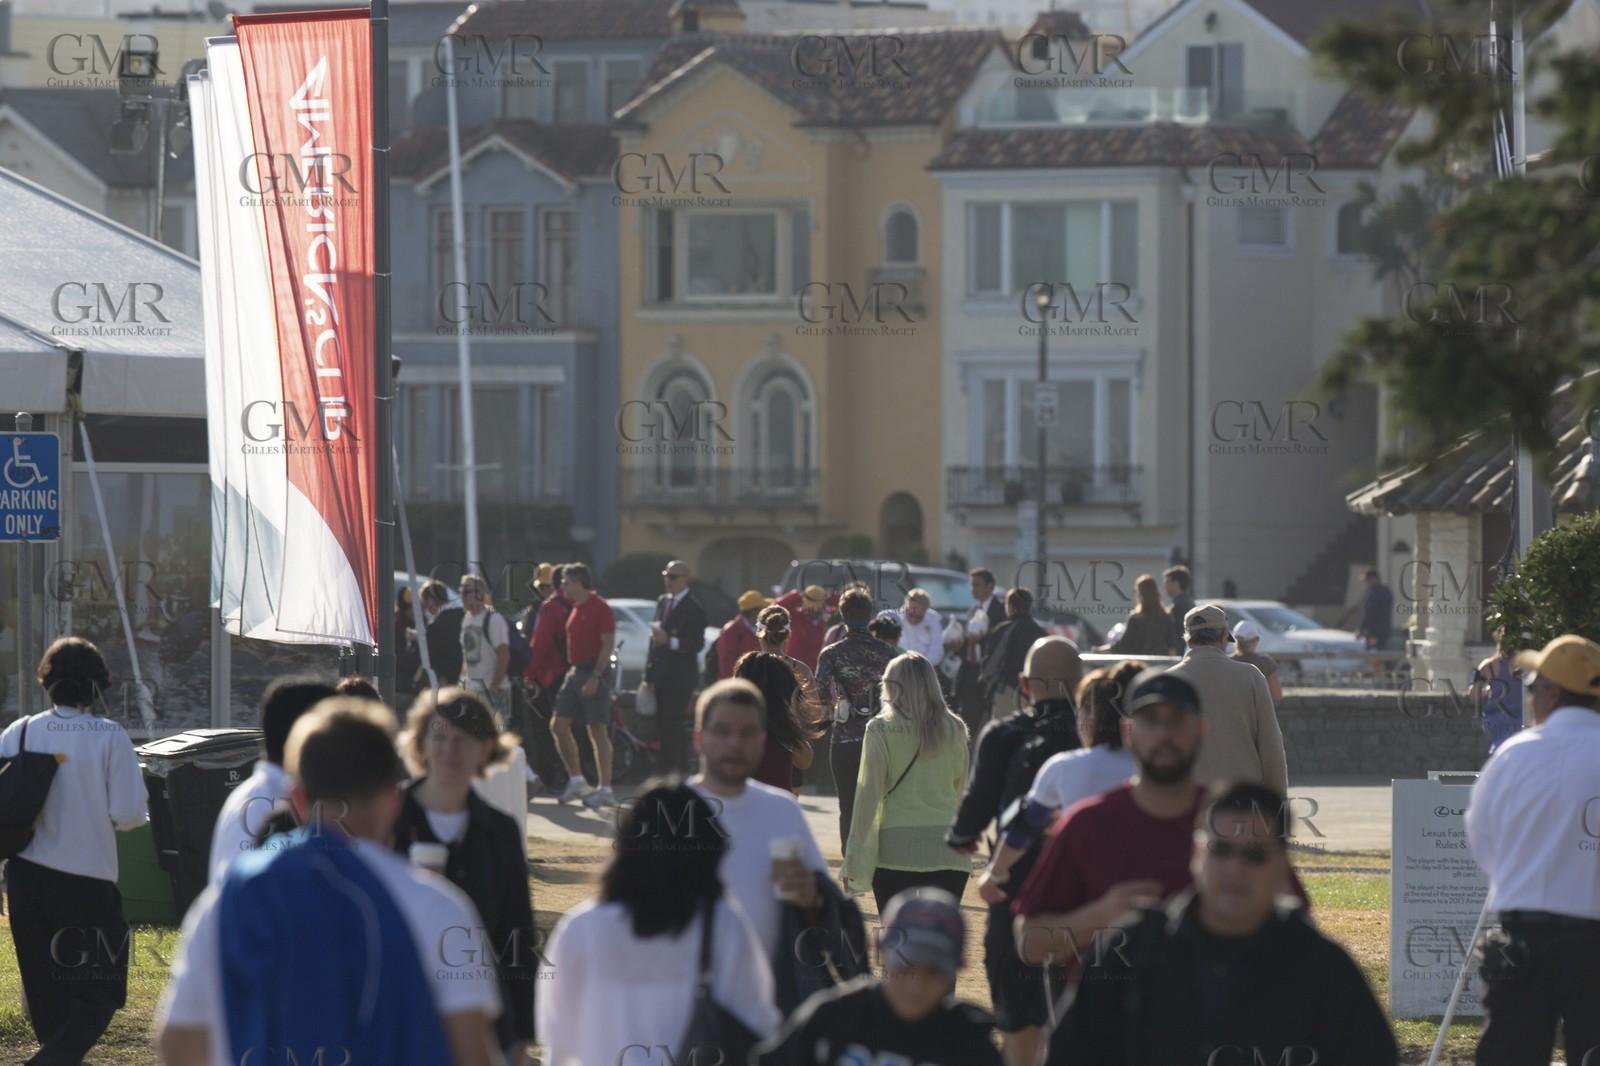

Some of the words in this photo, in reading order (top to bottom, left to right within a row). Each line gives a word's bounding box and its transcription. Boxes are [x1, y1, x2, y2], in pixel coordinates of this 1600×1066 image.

[0, 490, 57, 510] ARKING
[5, 514, 44, 535] ONLY
[1422, 828, 1446, 838] Lexus
[1435, 839, 1459, 849] Rules
[1460, 839, 1467, 849] &
